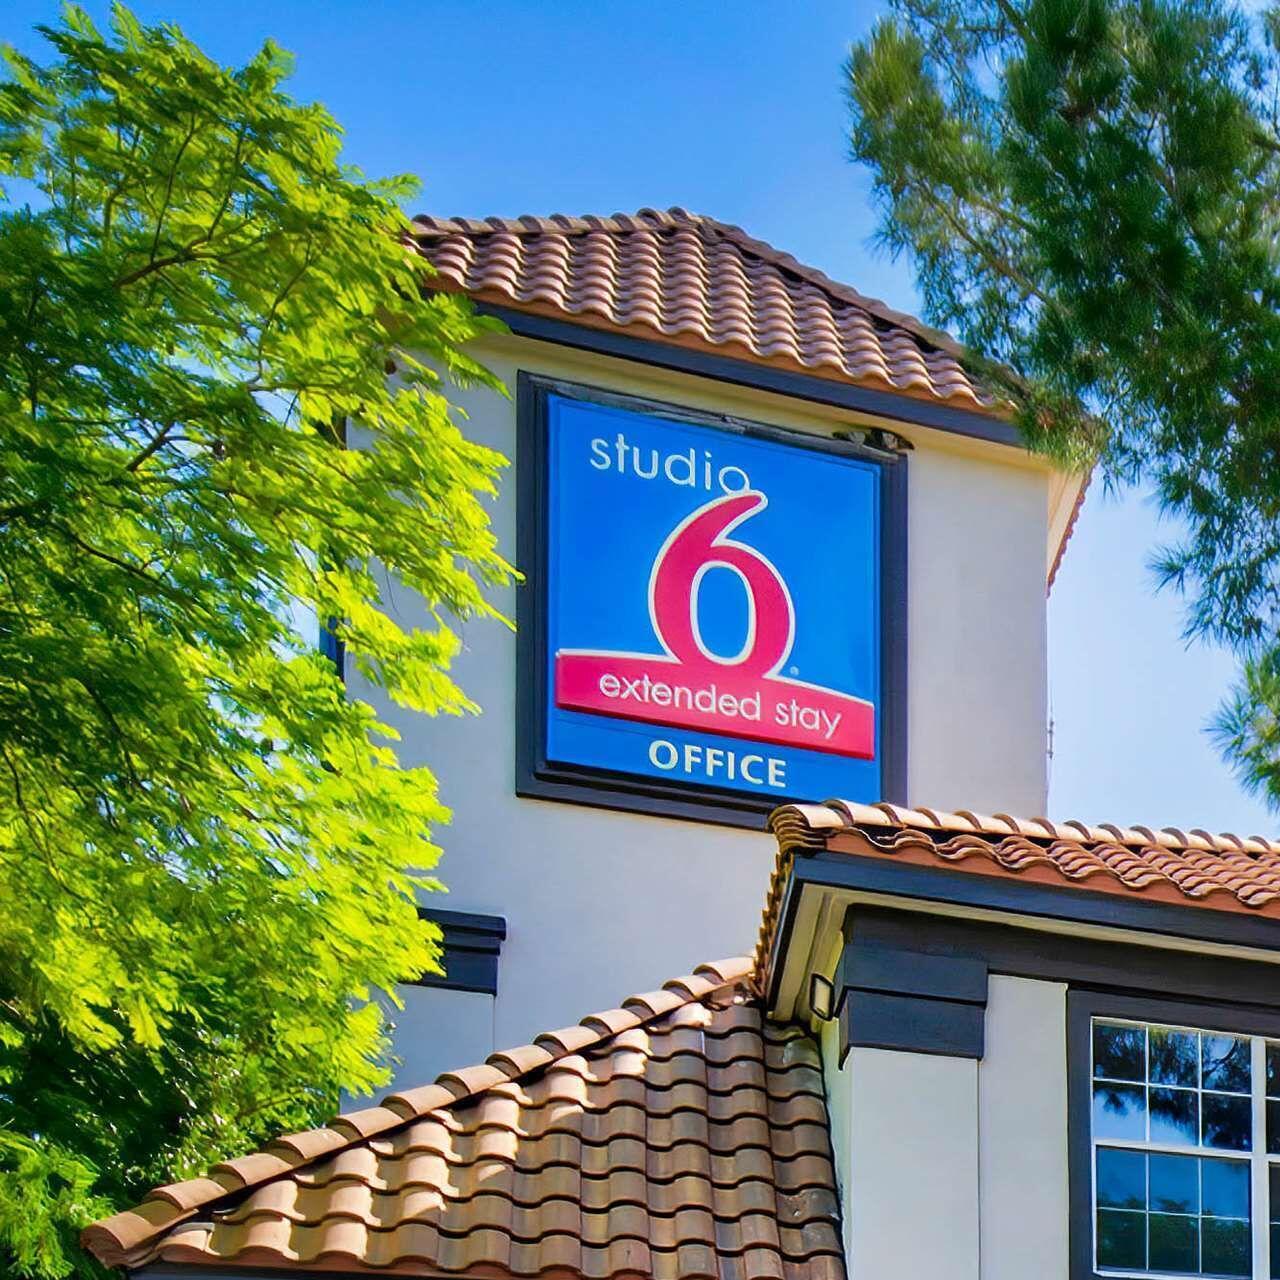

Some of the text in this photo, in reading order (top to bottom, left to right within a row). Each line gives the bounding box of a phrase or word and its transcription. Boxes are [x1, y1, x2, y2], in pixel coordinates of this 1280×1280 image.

[590, 433, 750, 497] studio
[648, 489, 796, 679] 6
[599, 673, 842, 739] extended stay
[649, 740, 787, 788] OFFICE
